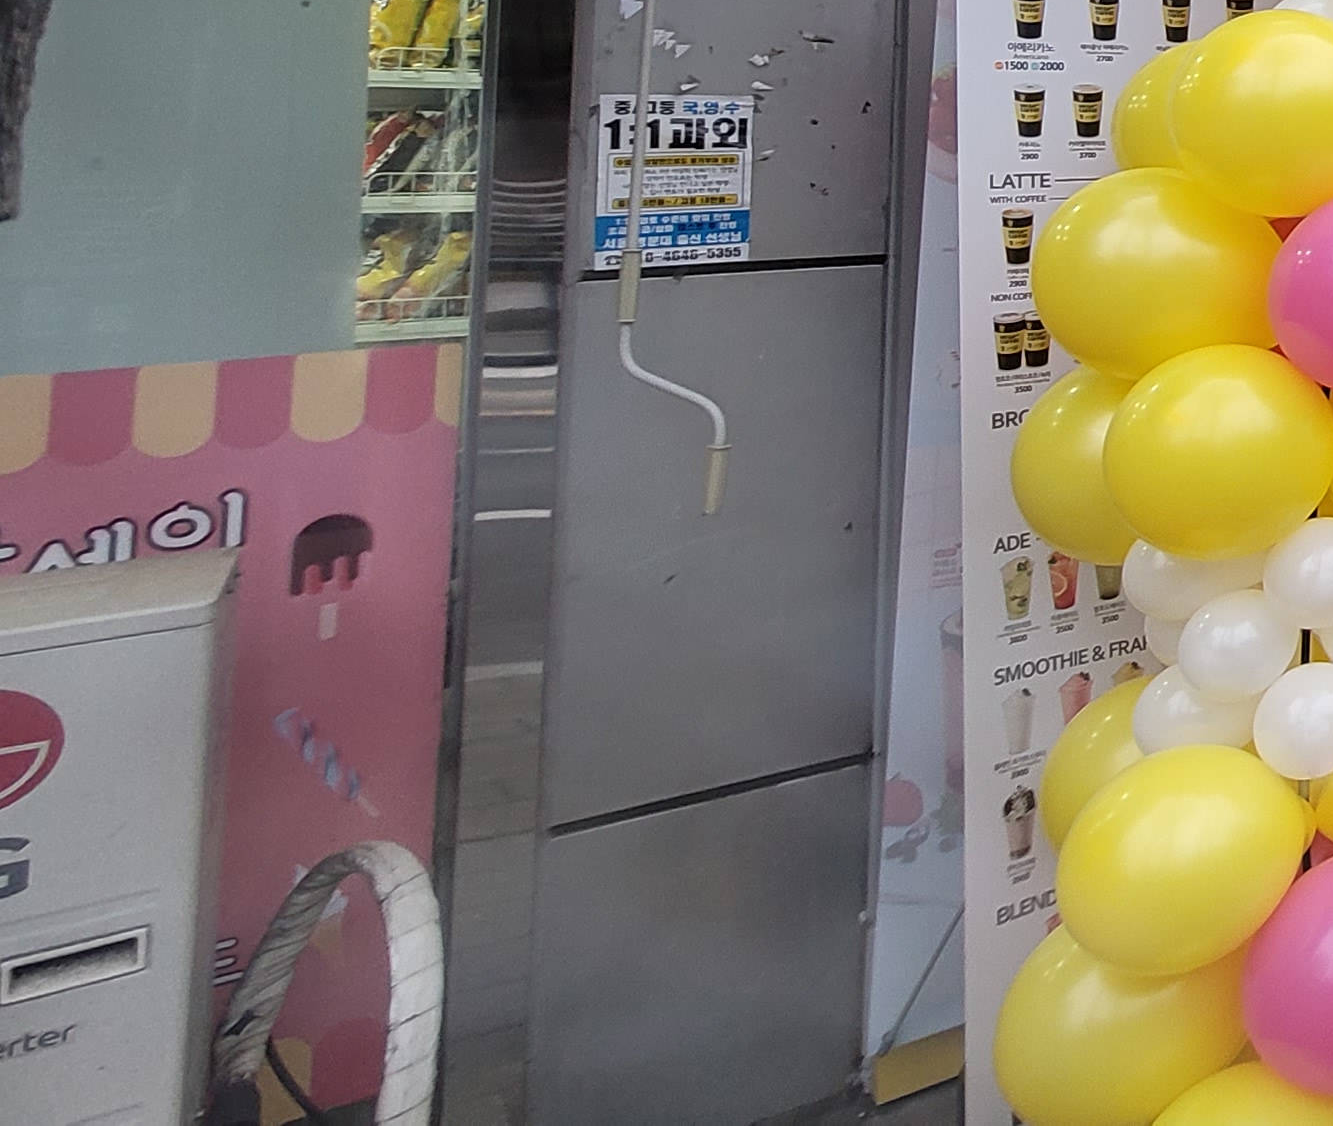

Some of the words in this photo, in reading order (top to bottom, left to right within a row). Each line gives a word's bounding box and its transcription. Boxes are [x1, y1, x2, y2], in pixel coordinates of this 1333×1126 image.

[1007, 41, 1056, 53] 아메리카노
[1004, 61, 1029, 71] 1500
[1039, 61, 1065, 71] 2000
[989, 173, 1052, 189] LATTE
[990, 195, 1013, 204] WITH
[1014, 195, 1047, 204] COFFEE
[991, 293, 1012, 302] NON
[993, 532, 1032, 555] ADE
[993, 648, 1090, 687] SMOOTHIE
[1091, 645, 1106, 662] &
